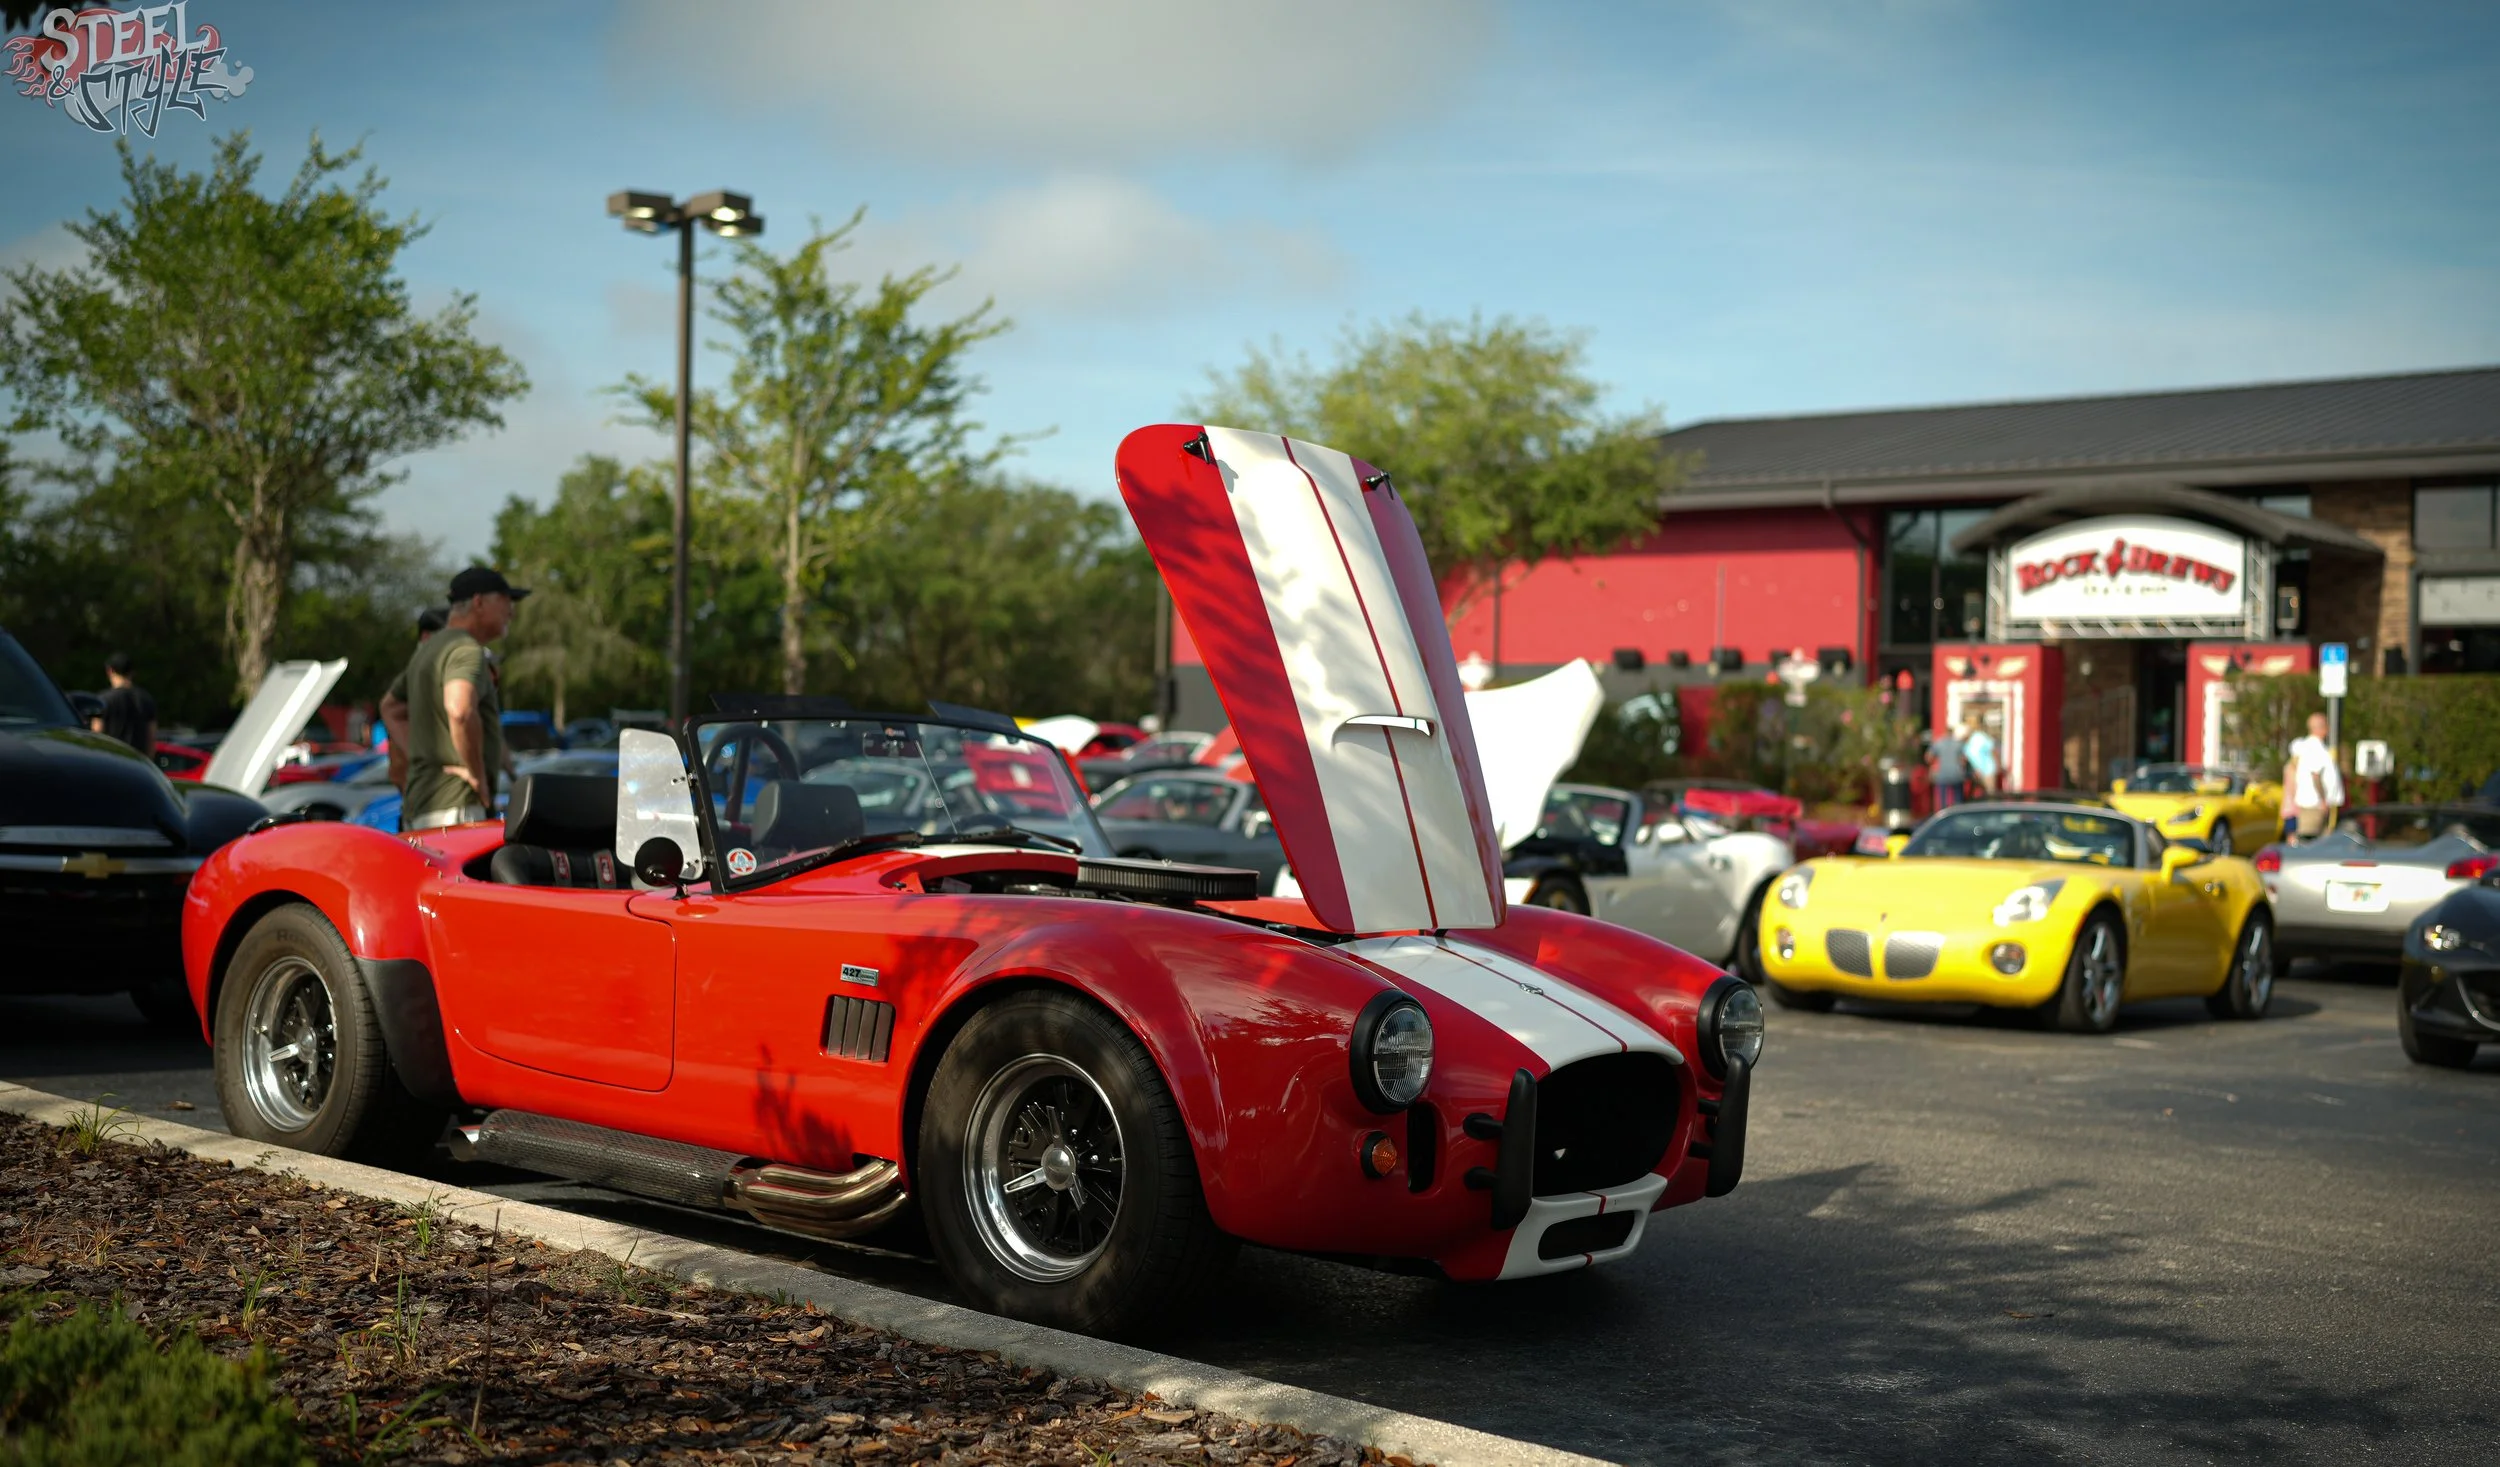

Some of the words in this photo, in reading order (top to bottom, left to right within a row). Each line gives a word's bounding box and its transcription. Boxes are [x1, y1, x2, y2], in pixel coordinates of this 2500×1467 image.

[2017, 549, 2101, 595] ROCK
[2125, 544, 2236, 595] BREWS
[842, 967, 861, 977] 427
